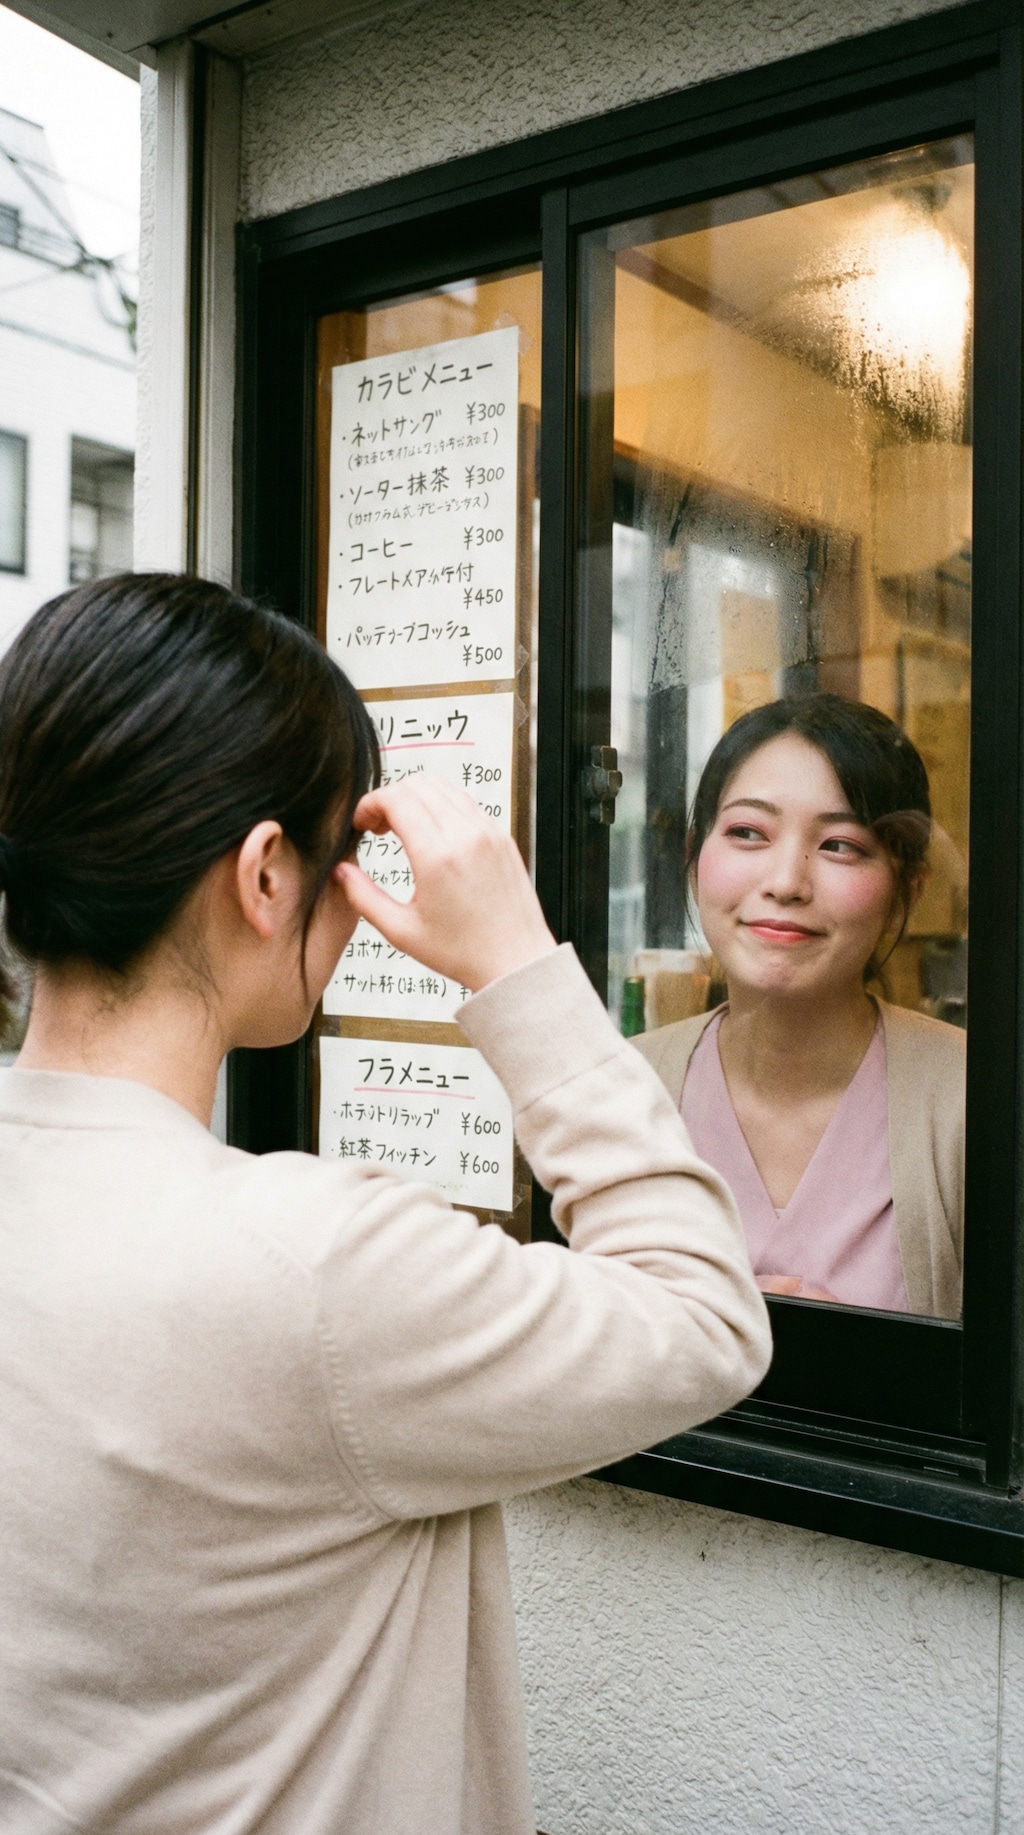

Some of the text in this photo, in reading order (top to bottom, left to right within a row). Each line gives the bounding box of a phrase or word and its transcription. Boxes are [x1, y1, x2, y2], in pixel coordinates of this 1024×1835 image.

[466, 401, 506, 425] ¥300
[464, 465, 505, 489] ¥300
[350, 525, 504, 563] コーヒー ¥300
[462, 587, 504, 609] ¥450
[462, 644, 503, 667] ¥500
[462, 763, 502, 787] ¥300
[358, 1058, 470, 1088] フラメニュー
[461, 1111, 501, 1135] ¥600
[459, 1151, 500, 1175] ¥600
